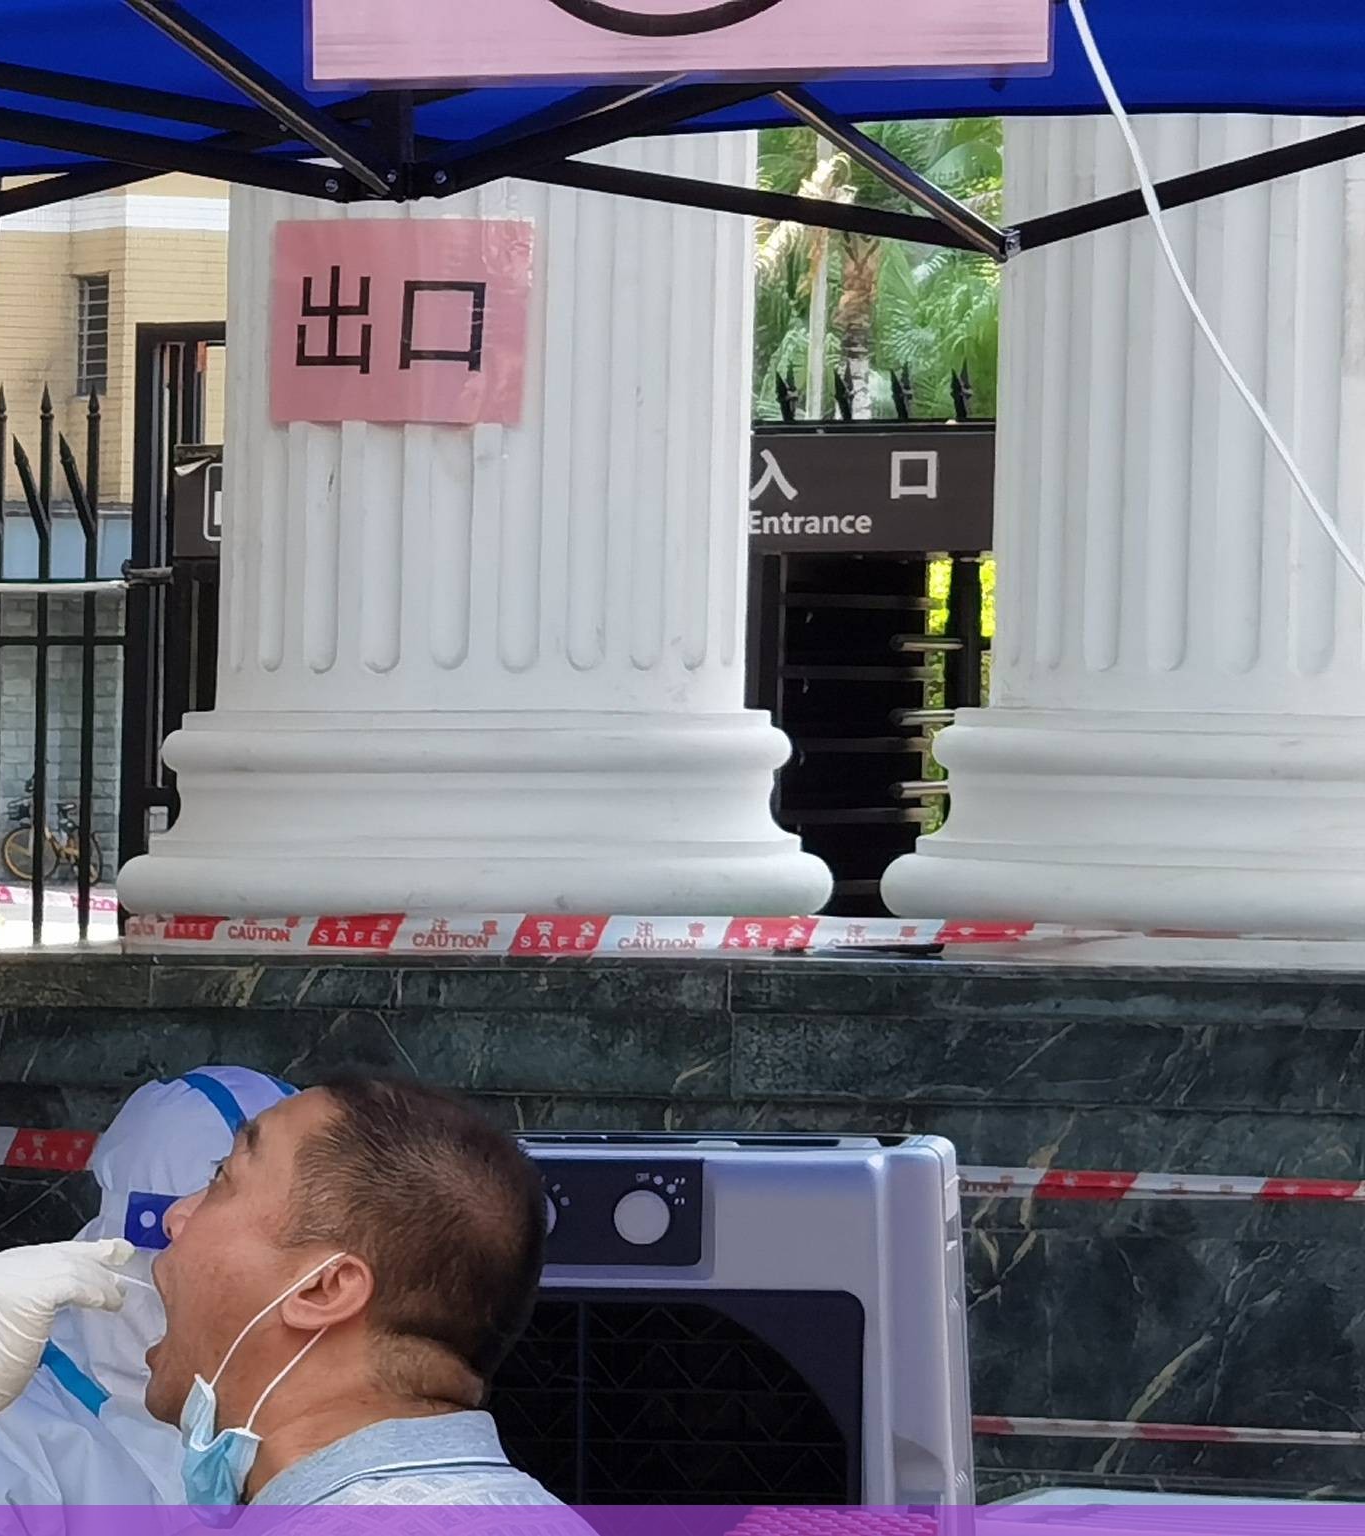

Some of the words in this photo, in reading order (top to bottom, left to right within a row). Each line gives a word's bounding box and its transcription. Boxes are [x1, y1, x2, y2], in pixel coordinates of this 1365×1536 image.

[296, 265, 486, 374] 出口
[749, 449, 938, 501] 入口
[749, 509, 872, 535] Entrance
[227, 925, 290, 942] CAUTION
[319, 930, 382, 945] SAFE
[412, 933, 490, 948] CAUTION
[520, 935, 588, 948] SAFE
